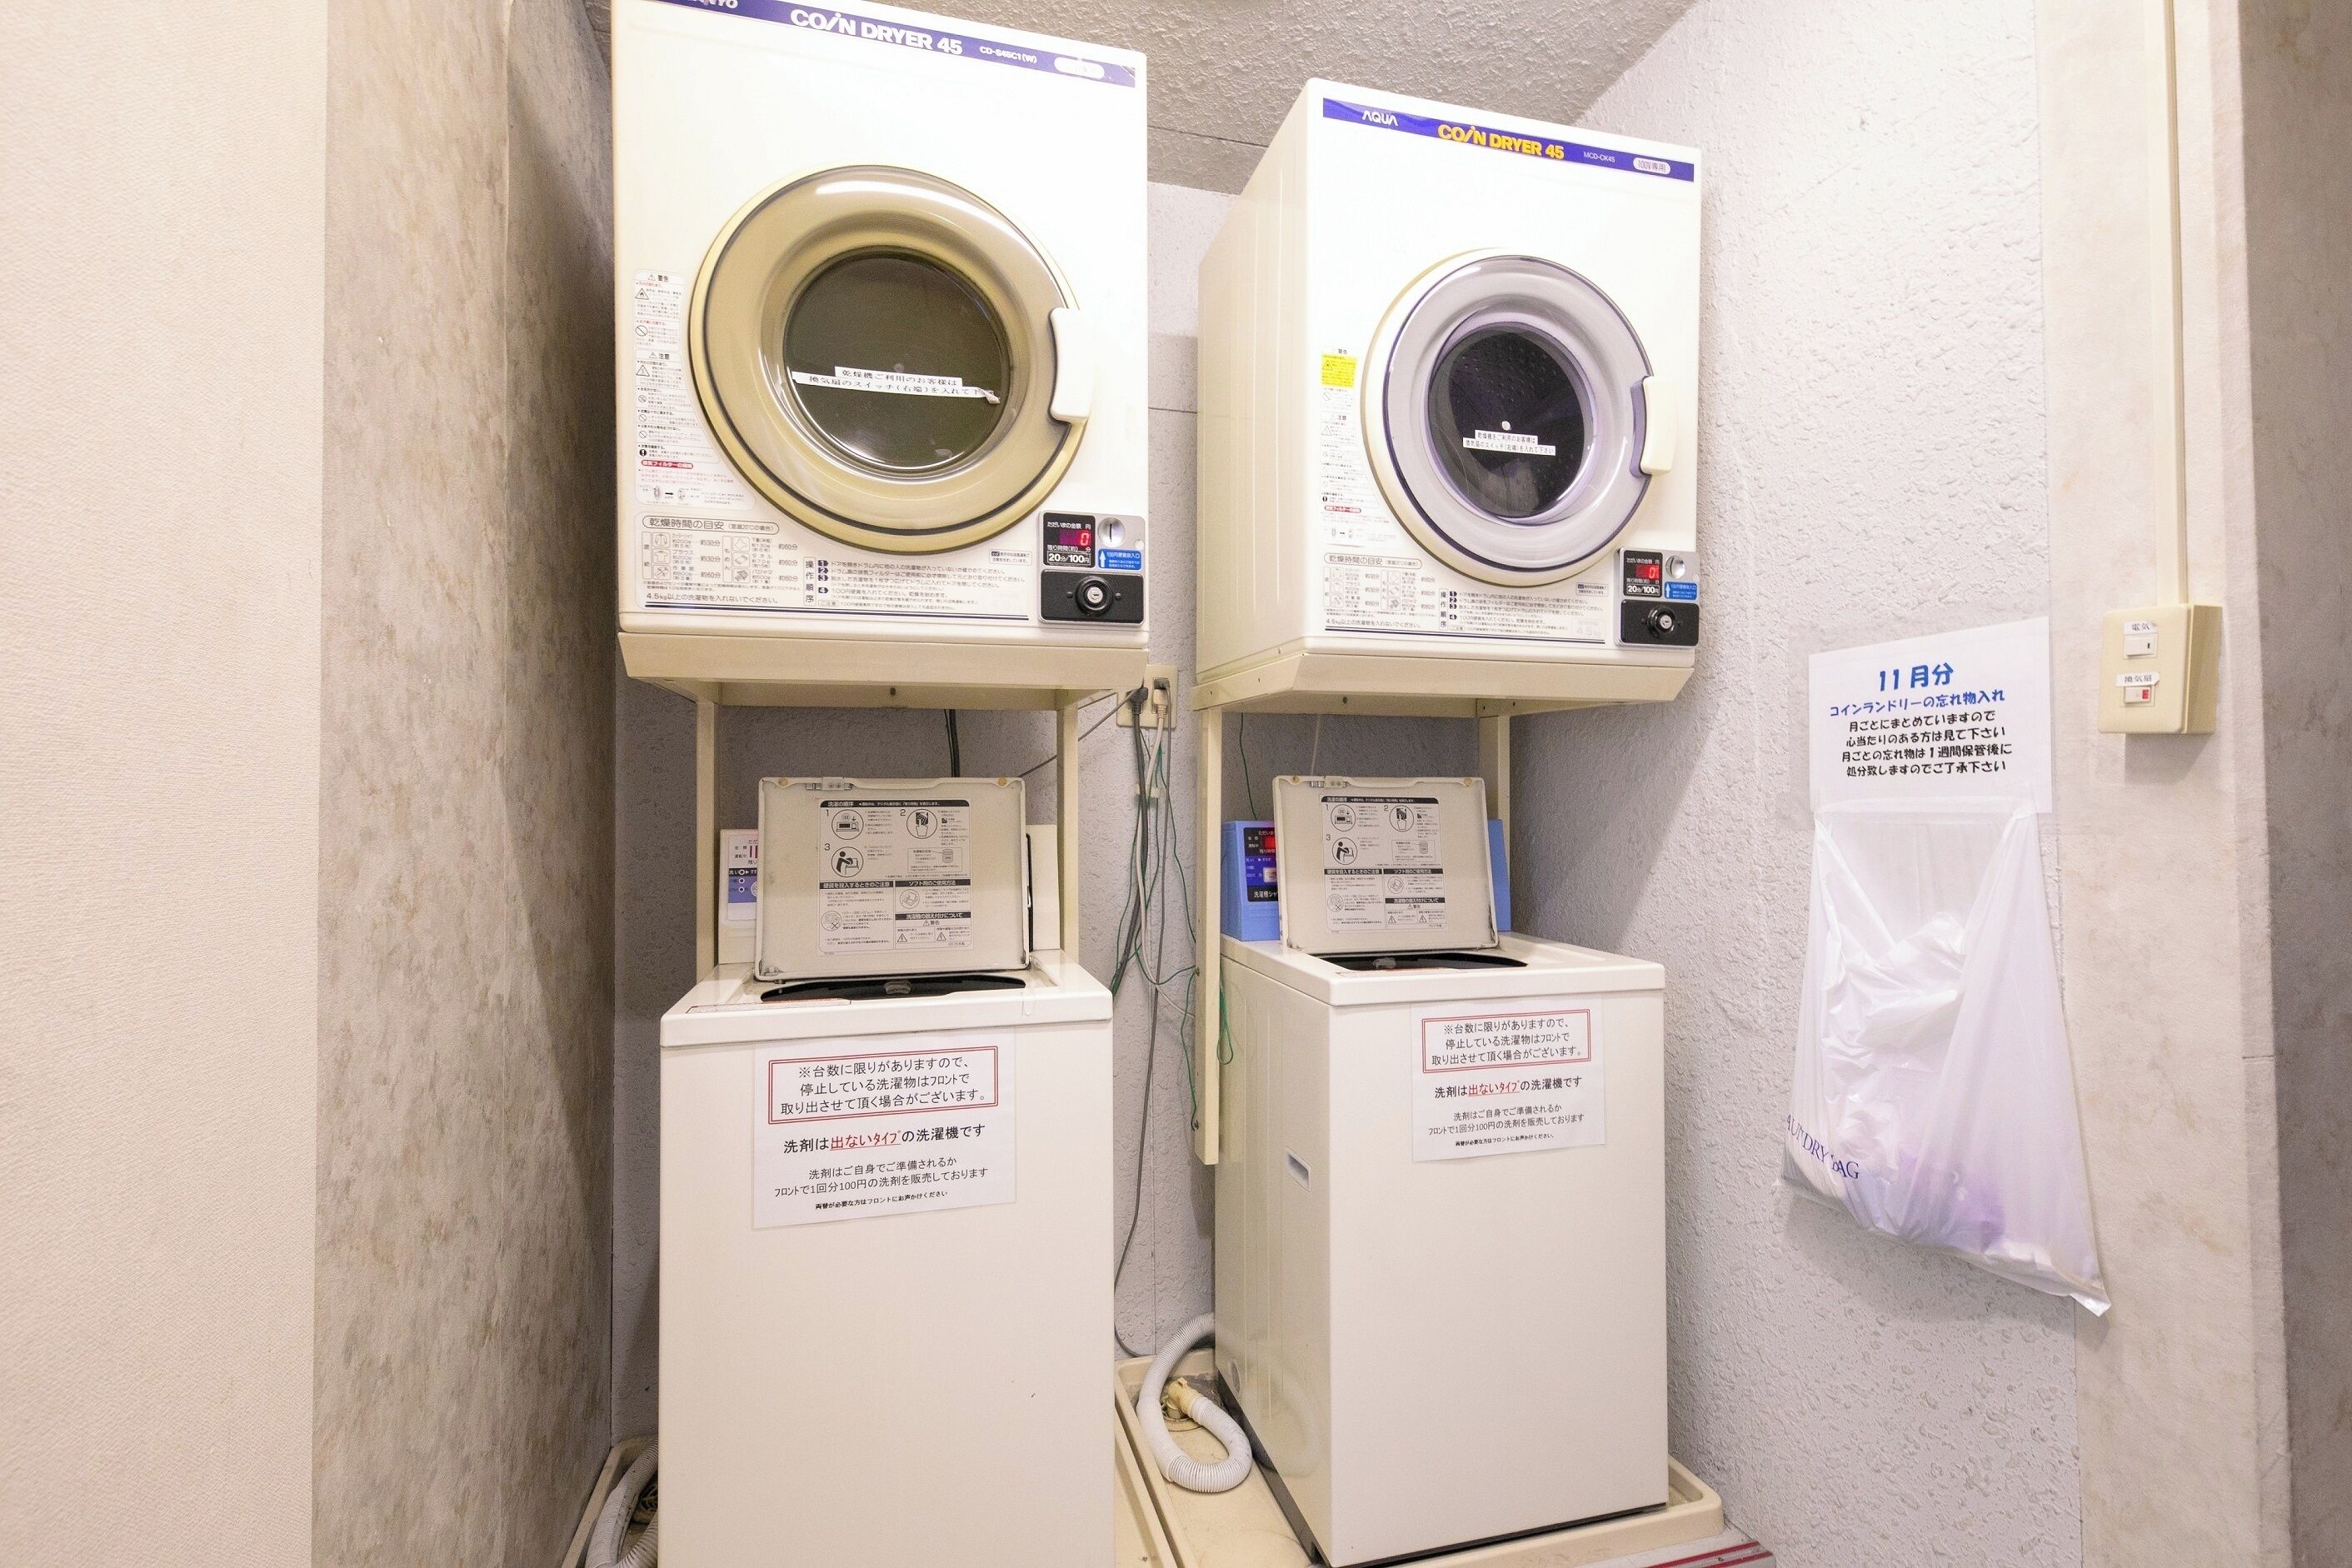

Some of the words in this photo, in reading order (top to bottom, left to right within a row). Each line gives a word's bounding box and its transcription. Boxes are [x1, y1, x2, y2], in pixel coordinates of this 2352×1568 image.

[861, 21, 933, 50] DRYER
[937, 37, 962, 55] 45
[1361, 109, 1398, 127] AQUA
[1489, 135, 1542, 157] DRYER
[1545, 144, 1564, 160] 45
[1583, 152, 1615, 162] MCD-CK45
[1637, 160, 1666, 172] 100V専用
[649, 517, 725, 531] 乾燥時間の目安
[1080, 532, 1090, 547] 0
[1048, 552, 1090, 563] 20分/100円
[1329, 554, 1383, 566] 乾燥時間の目安
[806, 560, 814, 603] 操作順序
[1830, 688, 2006, 717] コインランドリーの忘れ物入れ
[1849, 710, 1996, 732] 月ごとにまとめていますので
[1845, 726, 2006, 747] 心当たりのある方は見て下さい
[1841, 743, 2013, 762] 月ごとの忘れ物は1週間保管後に
[1846, 760, 2006, 777] 処分致しますのでご了承下さい
[900, 808, 906, 816] 2
[824, 842, 831, 851] 3
[1443, 1017, 1570, 1035] ※台数に限りがありますので、
[1431, 1046, 1582, 1066] 取り出させて頂く場合がございます。
[799, 1056, 969, 1078] ※台数に限りがありますので、
[780, 1088, 986, 1116] 取り出させて頂く場合がございます。
[1453, 1104, 1562, 1121] 洗剤はご自身でご準備されるか
[1786, 1113, 1829, 1164] AUDRY
[808, 1156, 957, 1181] 洗剤はご自身でご準備されるか
[815, 1190, 949, 1210] 両替が必要な方はフロントにお声かけください
